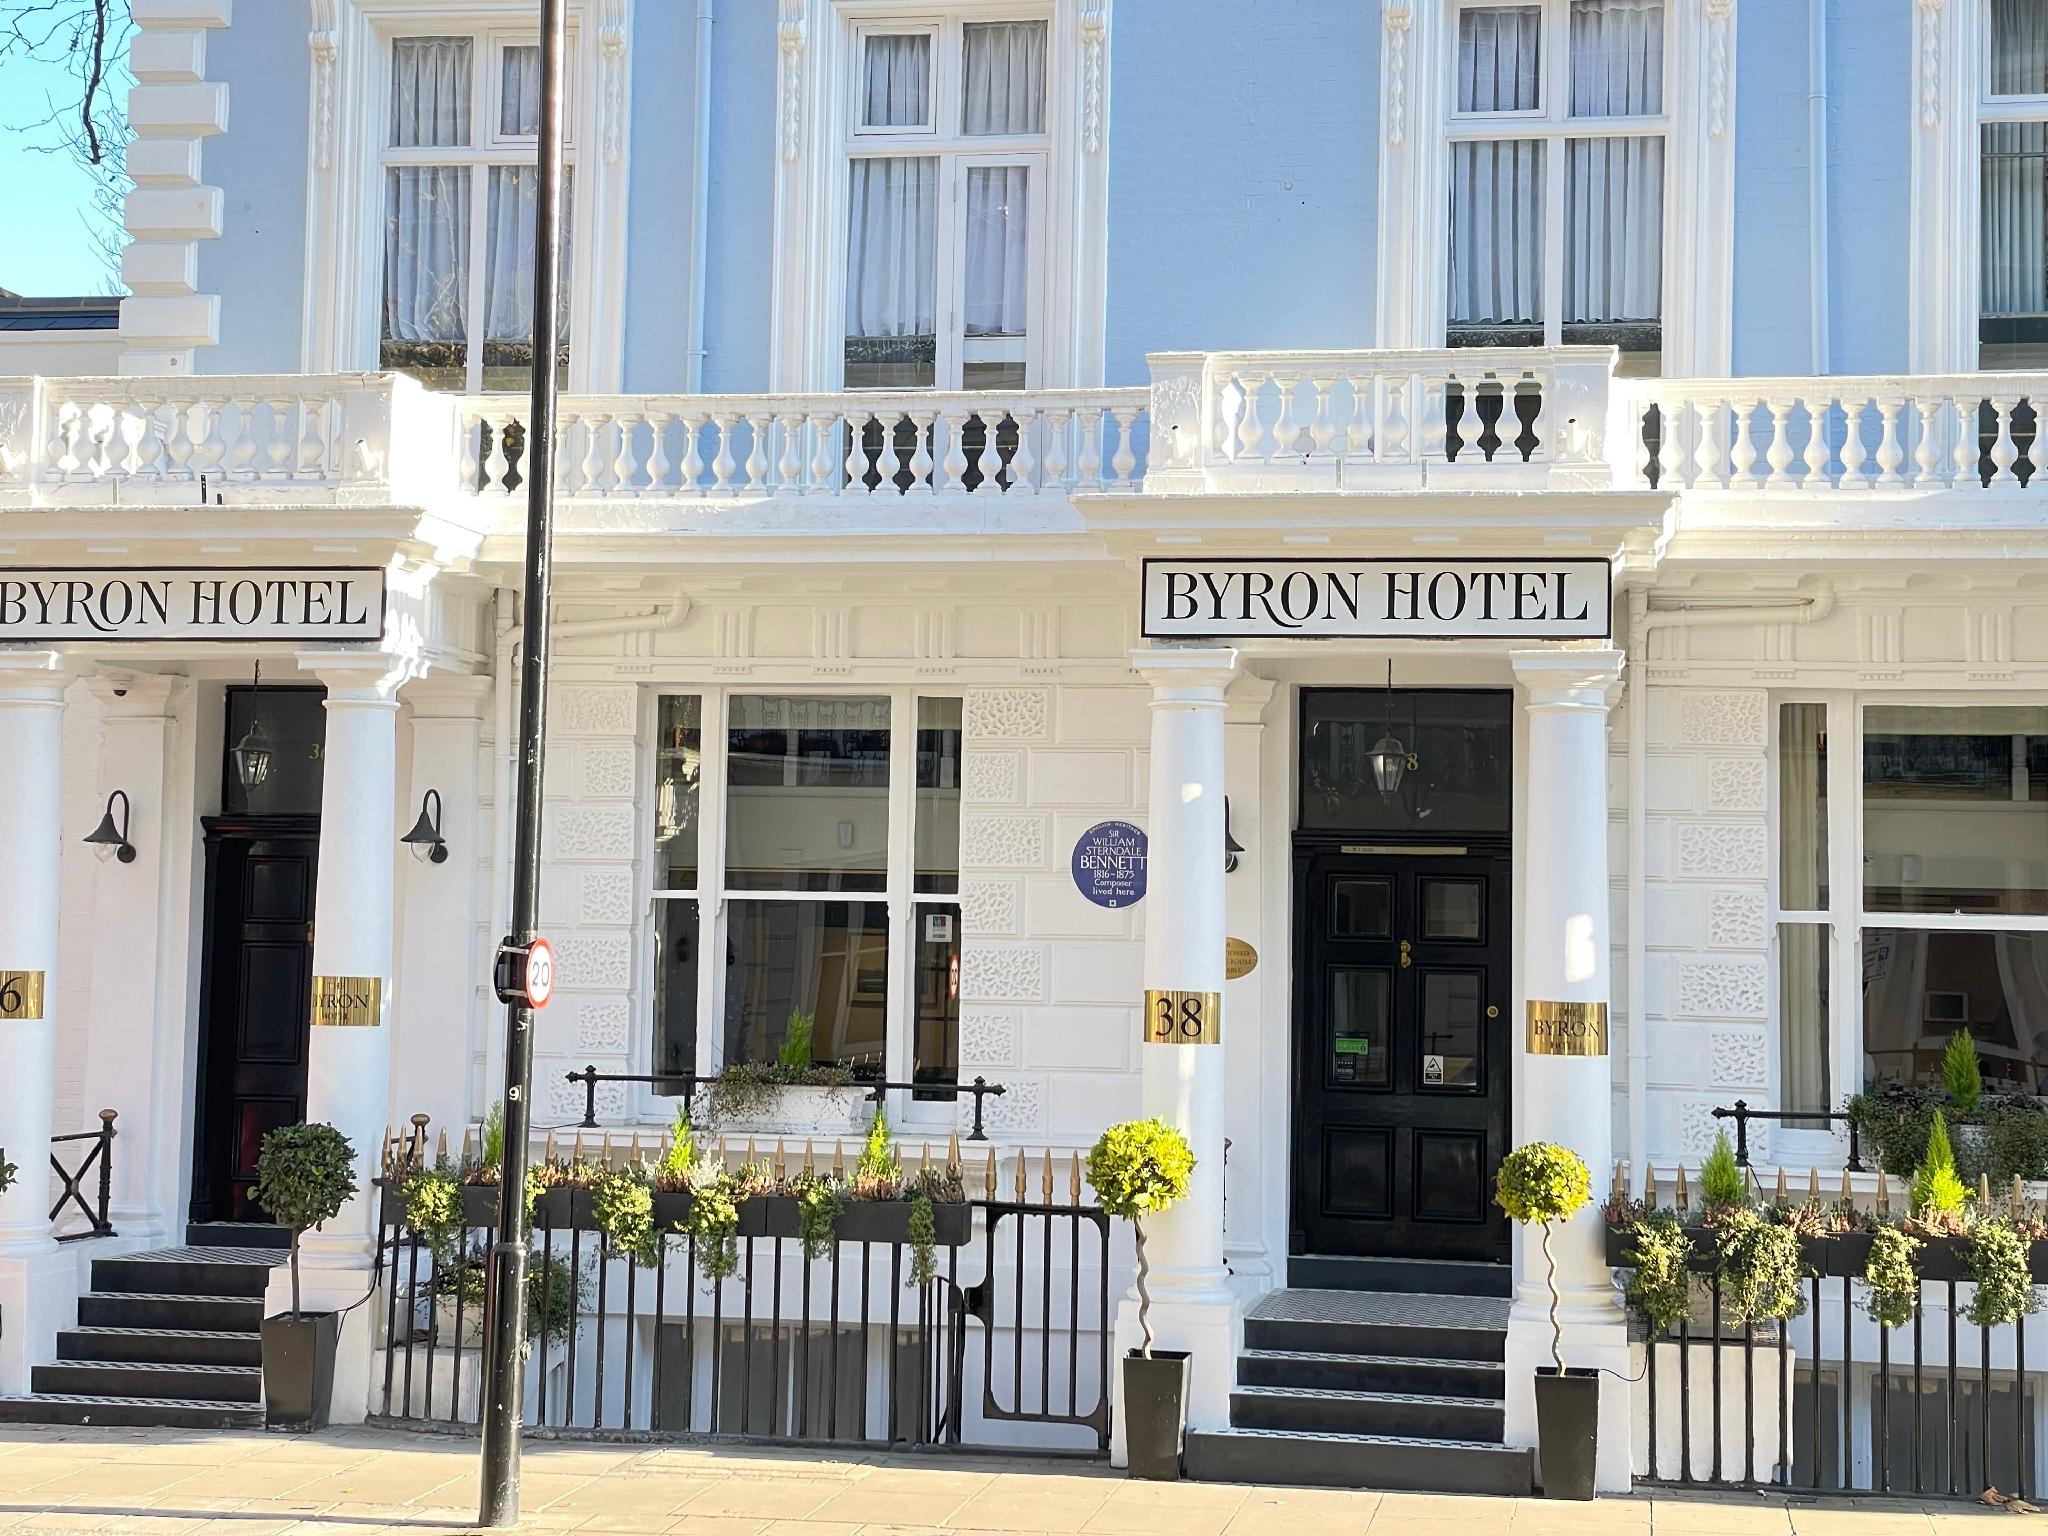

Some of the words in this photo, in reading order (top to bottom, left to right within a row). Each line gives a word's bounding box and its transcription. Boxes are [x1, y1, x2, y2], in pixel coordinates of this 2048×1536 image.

[0, 580, 173, 632] BYRON
[187, 579, 367, 625] HOTEL
[1161, 572, 1364, 628] BYRON
[1381, 572, 1588, 621] HOTEL
[1093, 837, 1135, 847] WILLIAM
[1086, 846, 1142, 856] STERNDALE
[1080, 855, 1147, 870] BENNETT
[1092, 886, 1113, 895] lived
[1116, 886, 1135, 896] here
[1094, 878, 1132, 889] Composer
[532, 961, 550, 987] 20
[312, 993, 369, 1009] BYRON
[1155, 997, 1202, 1037] 38
[1534, 1019, 1601, 1037] BYRON
